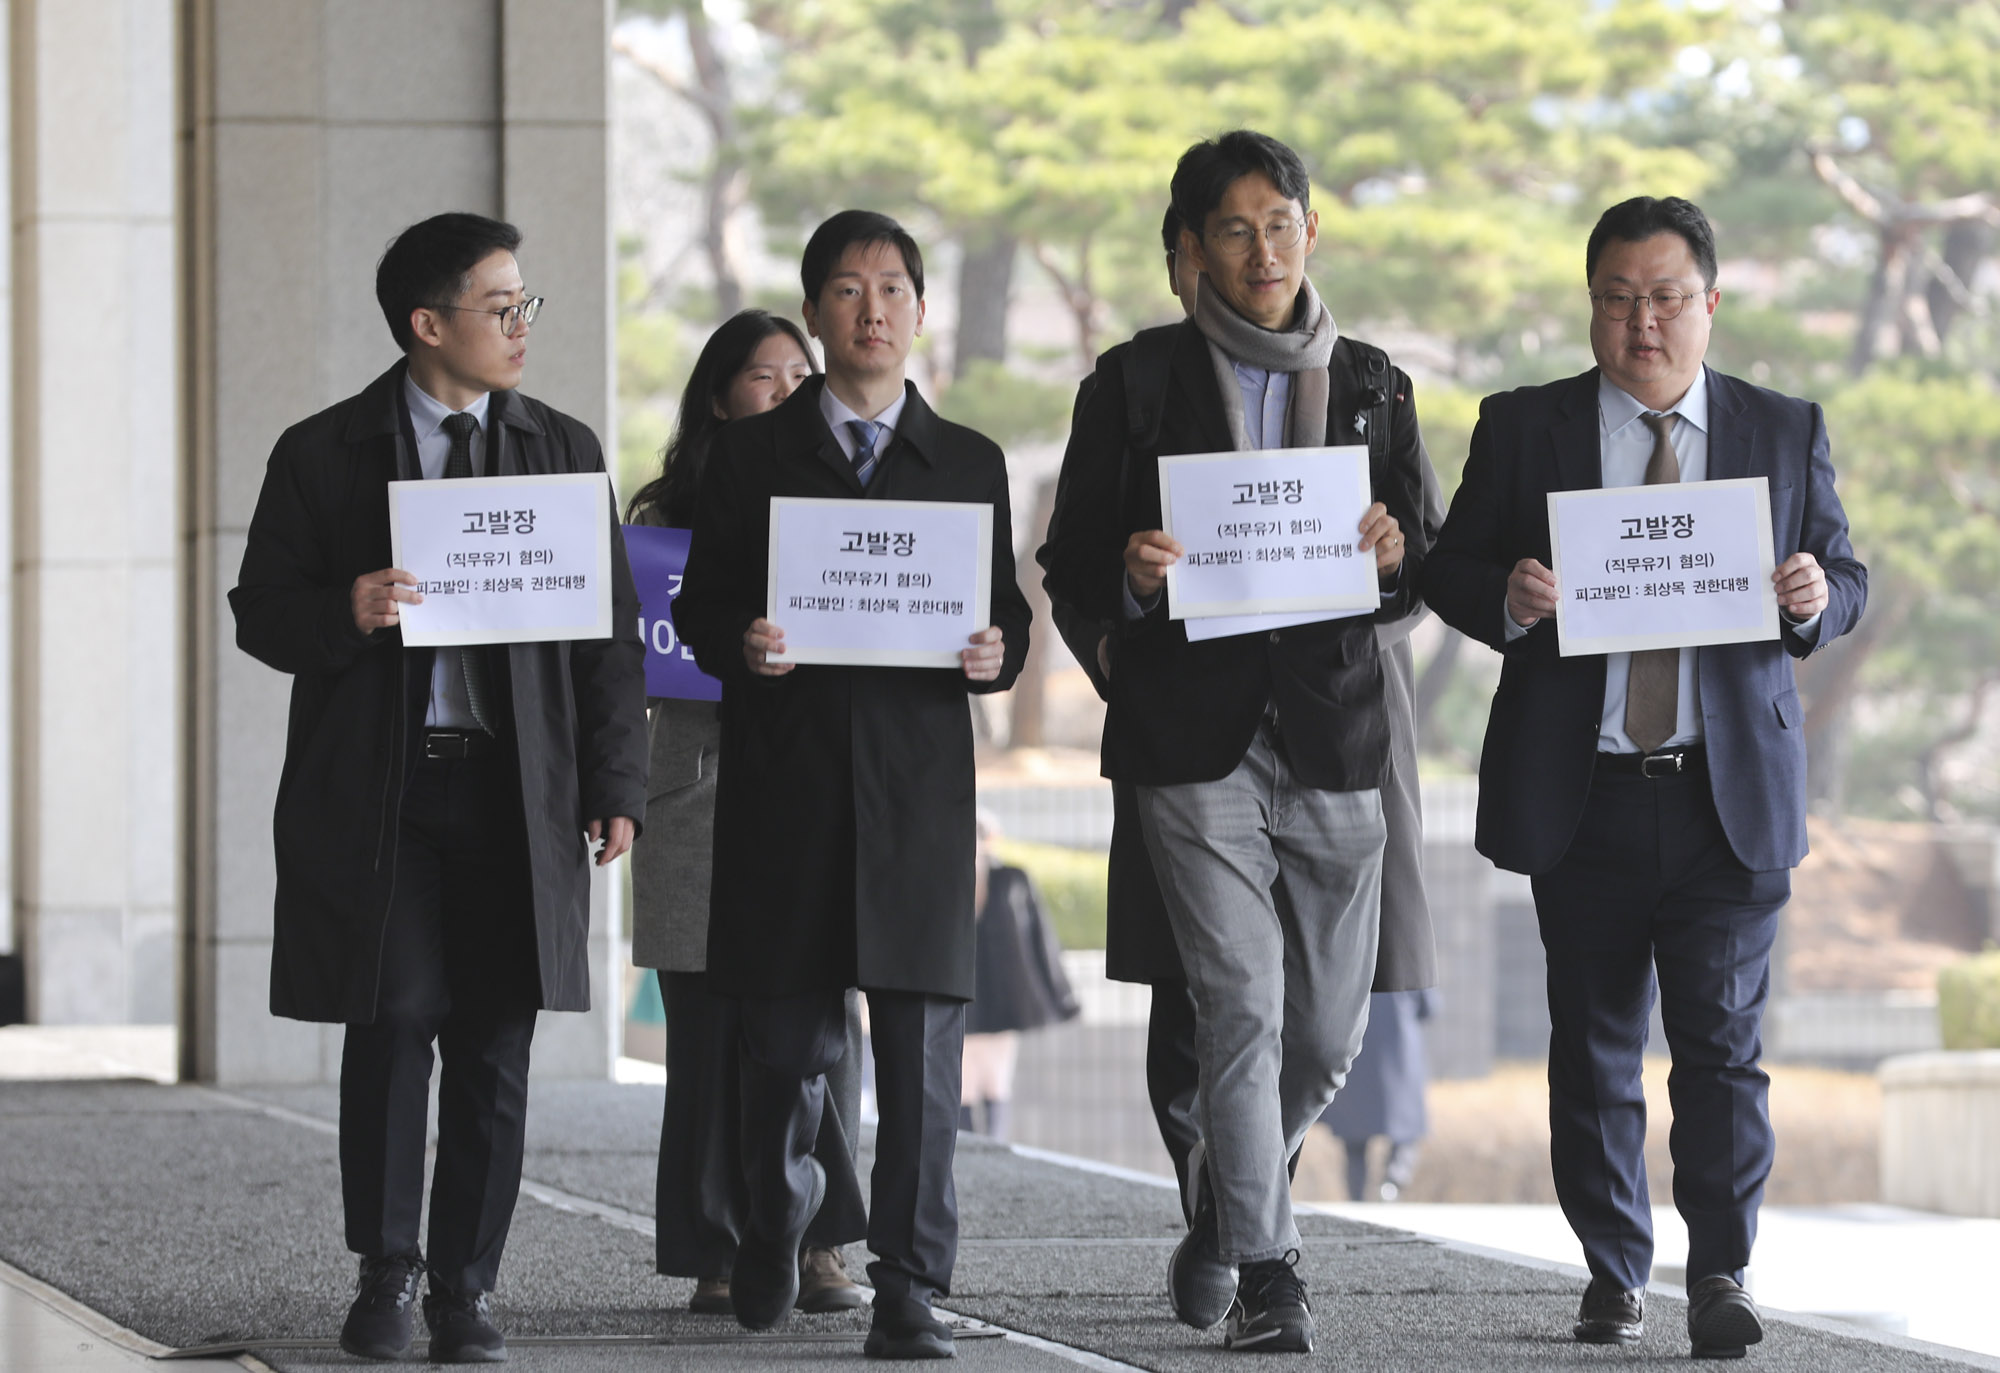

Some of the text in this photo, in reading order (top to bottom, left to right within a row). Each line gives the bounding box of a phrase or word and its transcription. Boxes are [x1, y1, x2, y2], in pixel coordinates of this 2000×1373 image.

[1231, 478, 1305, 506] 고발장
[461, 508, 537, 536] 고발장
[1217, 517, 1322, 540] (직무유기 혐의)
[1619, 512, 1696, 541] 고발장
[839, 530, 917, 558] 고발장
[1255, 546, 1296, 563] 최상목
[1302, 542, 1353, 560] 권한대행
[446, 548, 554, 569] (직무유기 혐의)
[1604, 551, 1715, 575] (직무유기 혐의)
[482, 577, 524, 594] 최상목
[530, 574, 586, 592] 권한대행
[821, 568, 932, 589] (직무유기 혐의)
[1643, 580, 1686, 598] 최상목
[1692, 576, 1750, 595] 권한대행
[857, 597, 900, 614] 최상목
[907, 599, 964, 616] 권한대행
